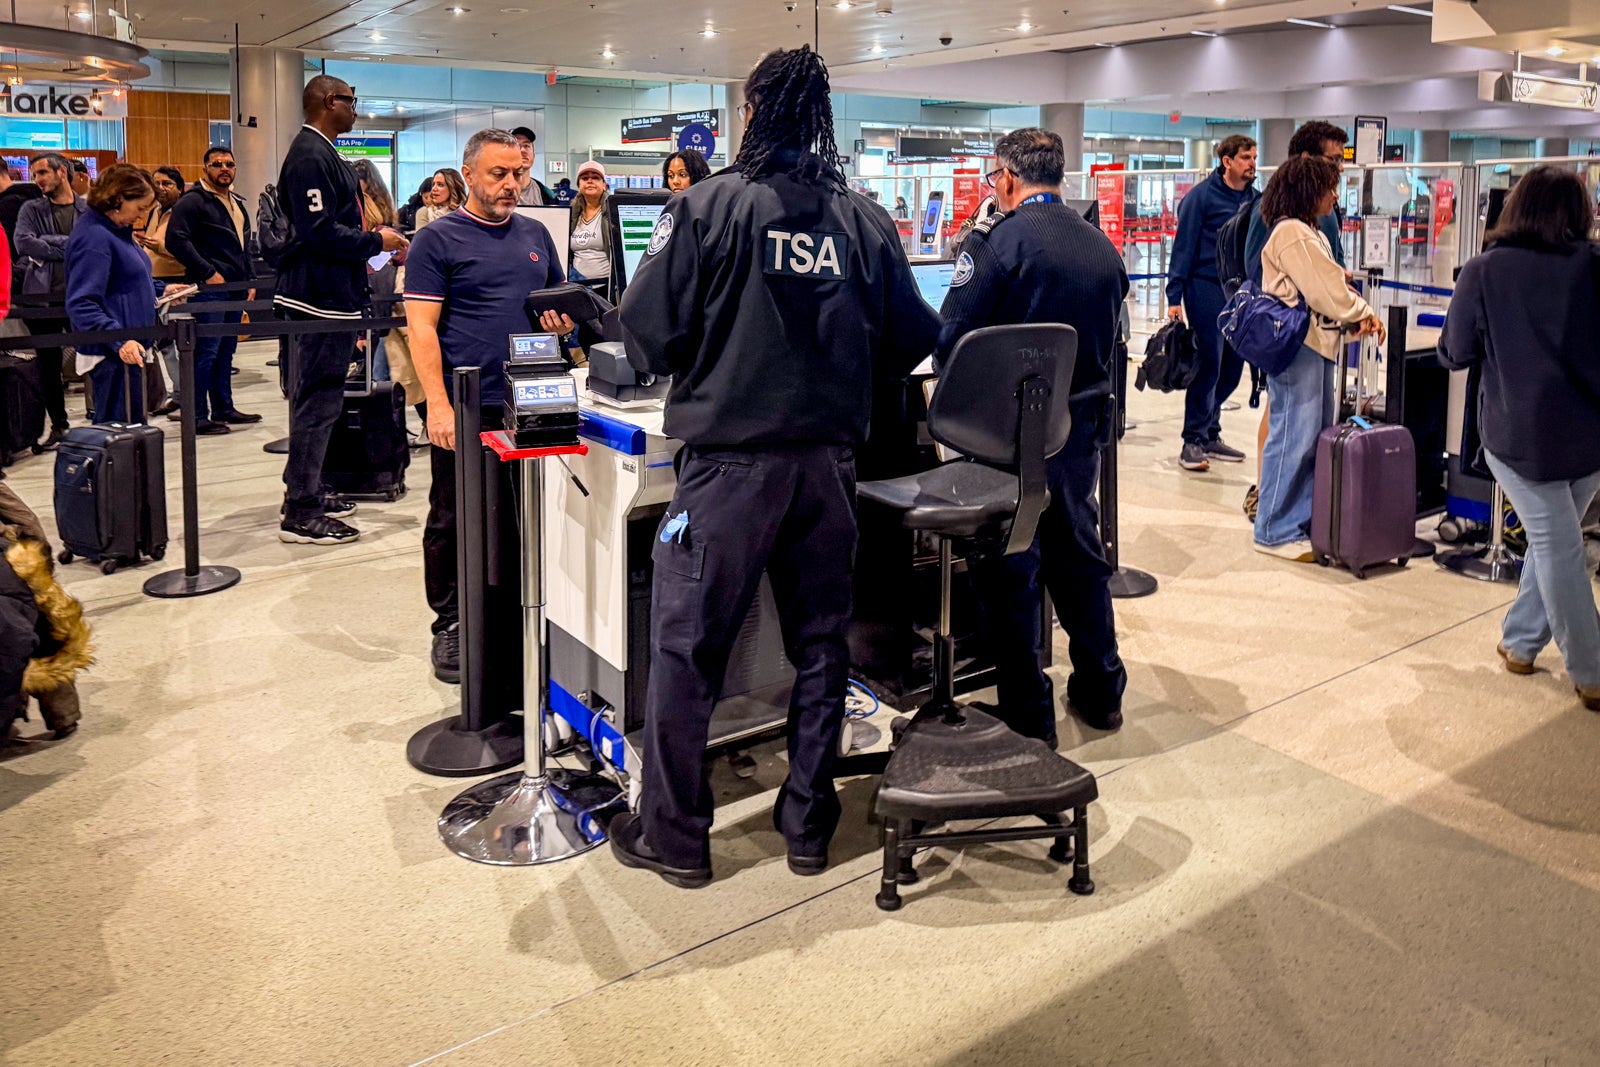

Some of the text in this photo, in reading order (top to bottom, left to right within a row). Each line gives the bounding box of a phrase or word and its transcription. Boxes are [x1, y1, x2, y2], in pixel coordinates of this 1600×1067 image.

[307, 189, 323, 212] 3
[1023, 197, 1035, 205] MIA
[767, 230, 842, 276] TSA
